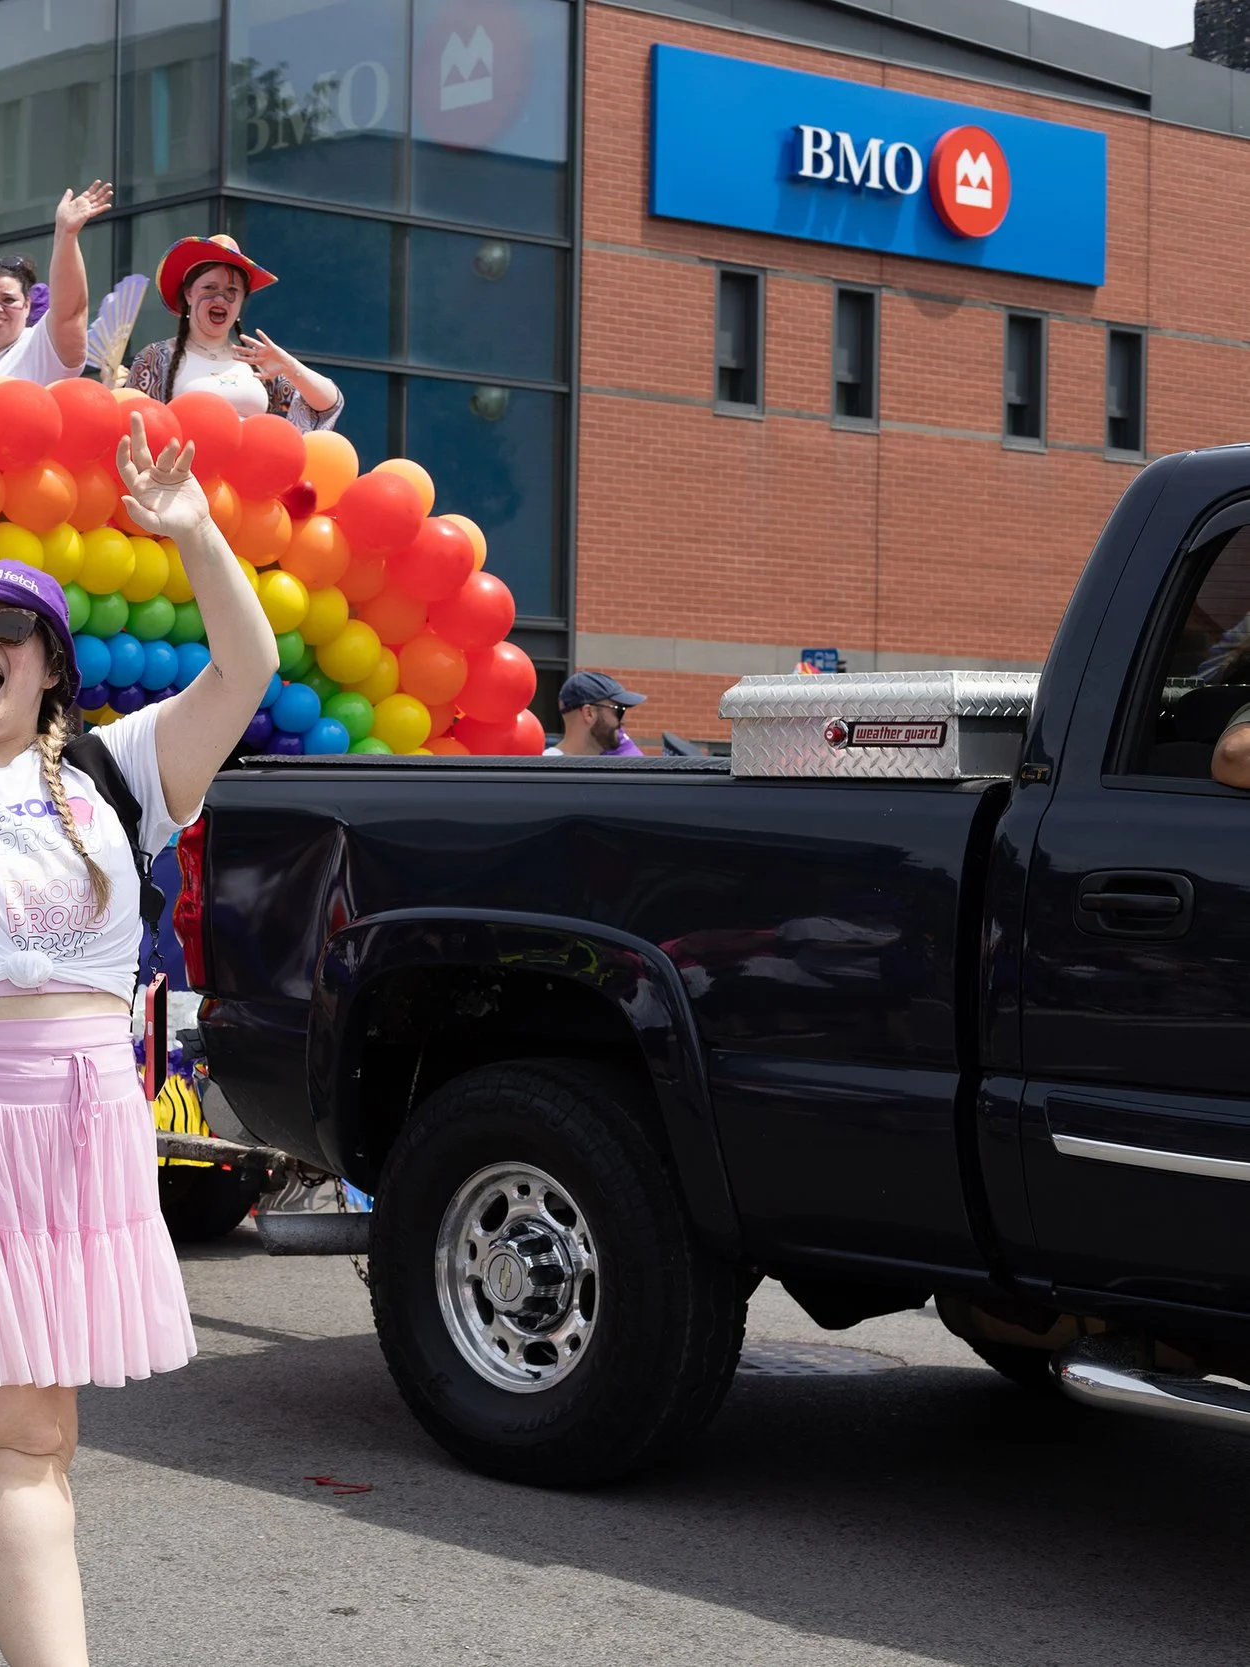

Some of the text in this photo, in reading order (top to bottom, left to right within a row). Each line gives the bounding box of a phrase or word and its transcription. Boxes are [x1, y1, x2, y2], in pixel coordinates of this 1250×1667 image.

[798, 124, 923, 195] BMO
[3, 570, 40, 595] fetch
[856, 726, 903, 741] weather
[4, 878, 97, 906] PROU
[6, 905, 111, 934] PROUD
